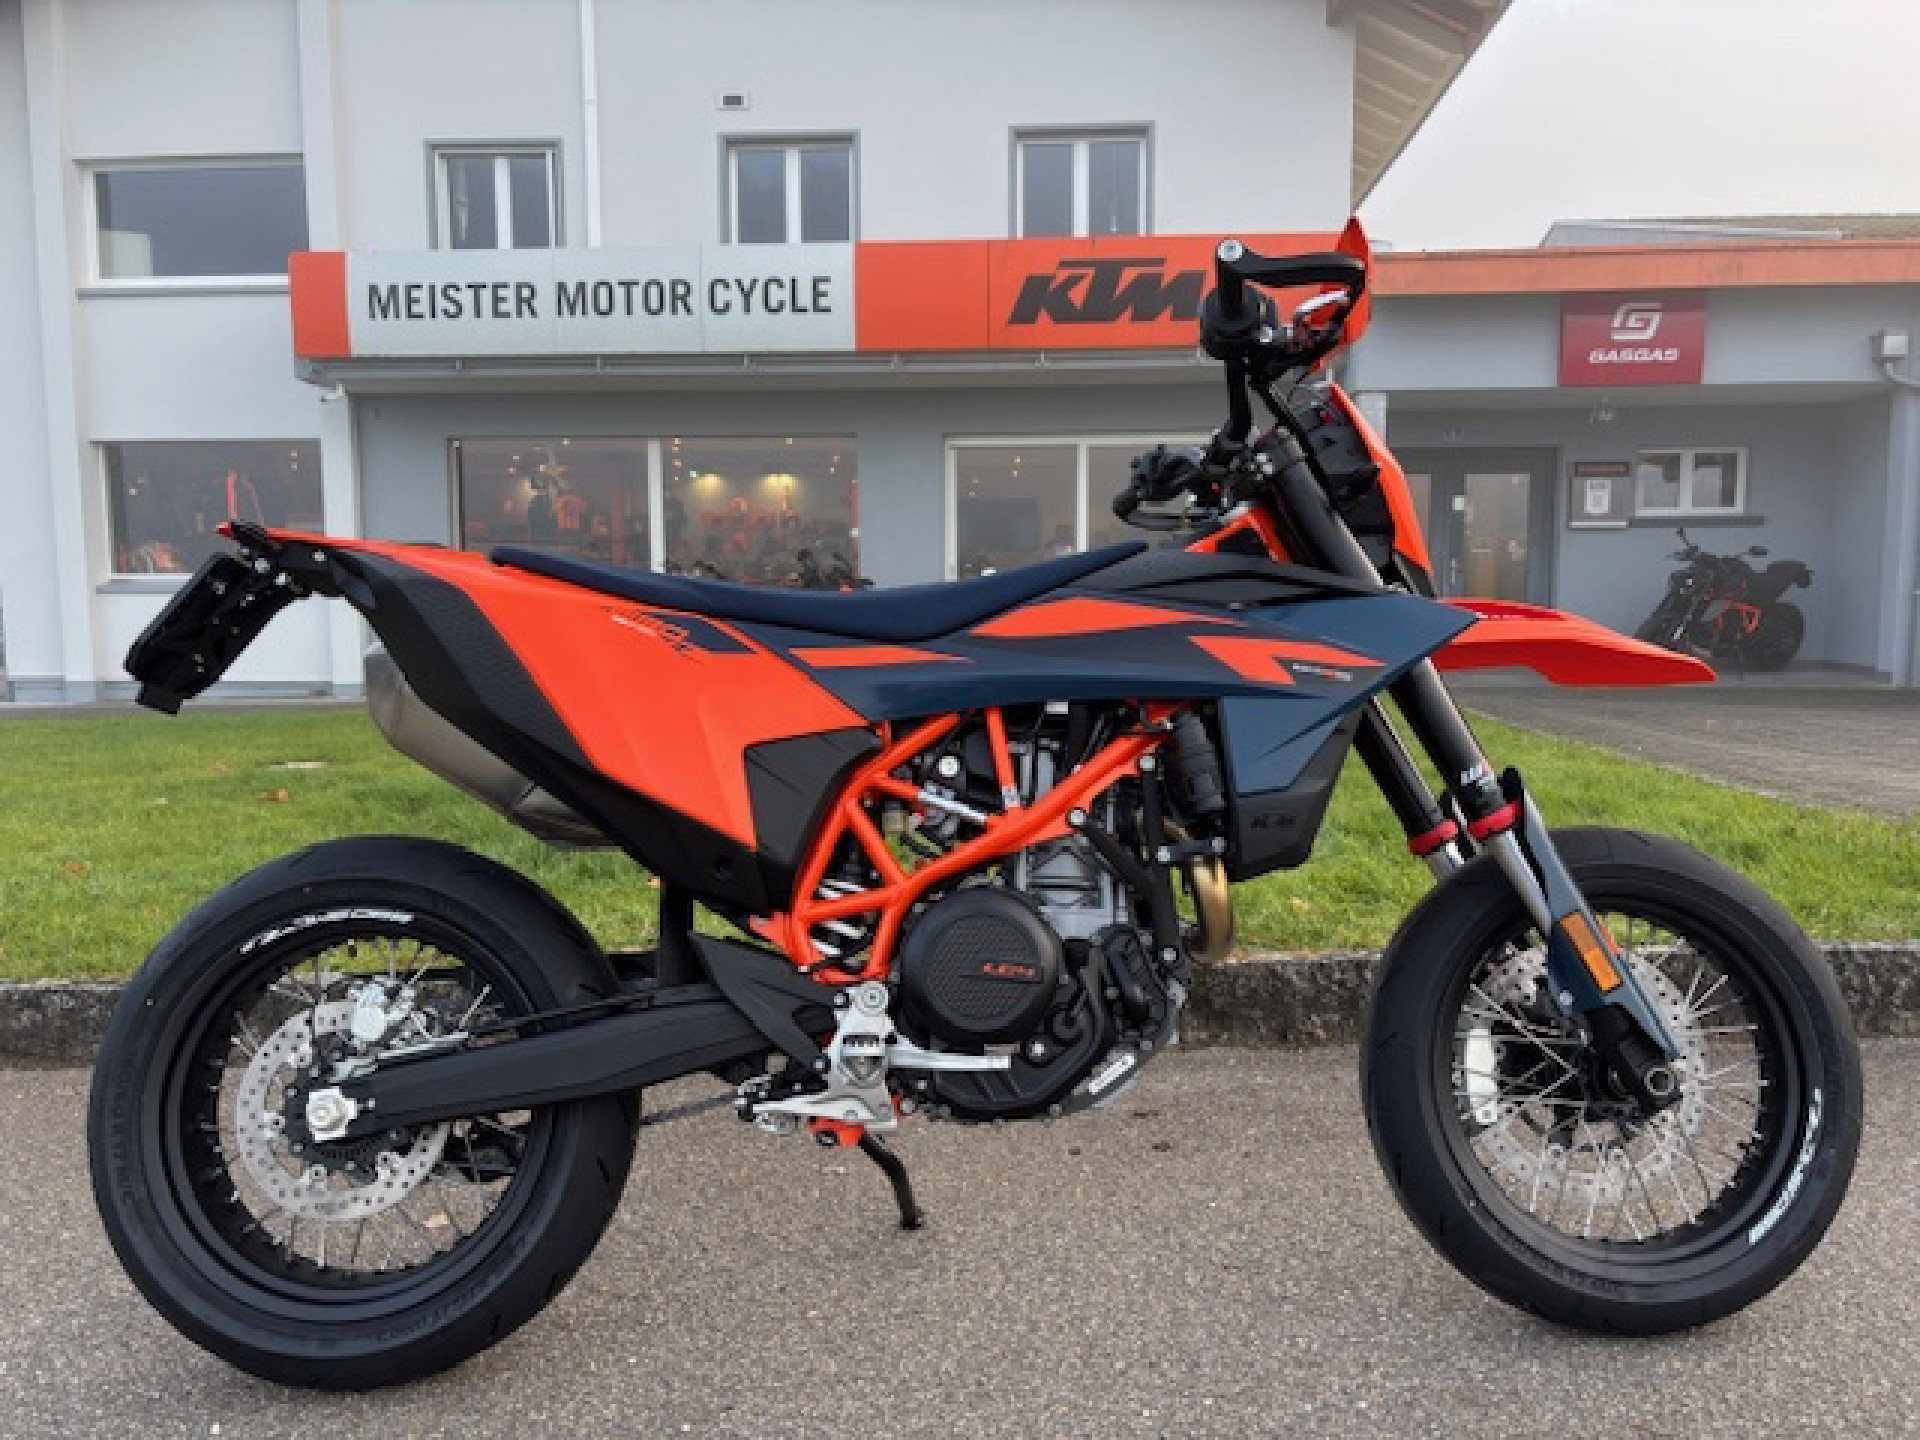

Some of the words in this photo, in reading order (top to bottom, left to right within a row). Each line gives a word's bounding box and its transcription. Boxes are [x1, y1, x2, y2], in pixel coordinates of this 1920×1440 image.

[367, 282, 538, 320] MEISTER
[556, 277, 694, 316] MOTOR
[707, 275, 833, 313] CYCLE
[1008, 257, 1206, 324] KTM
